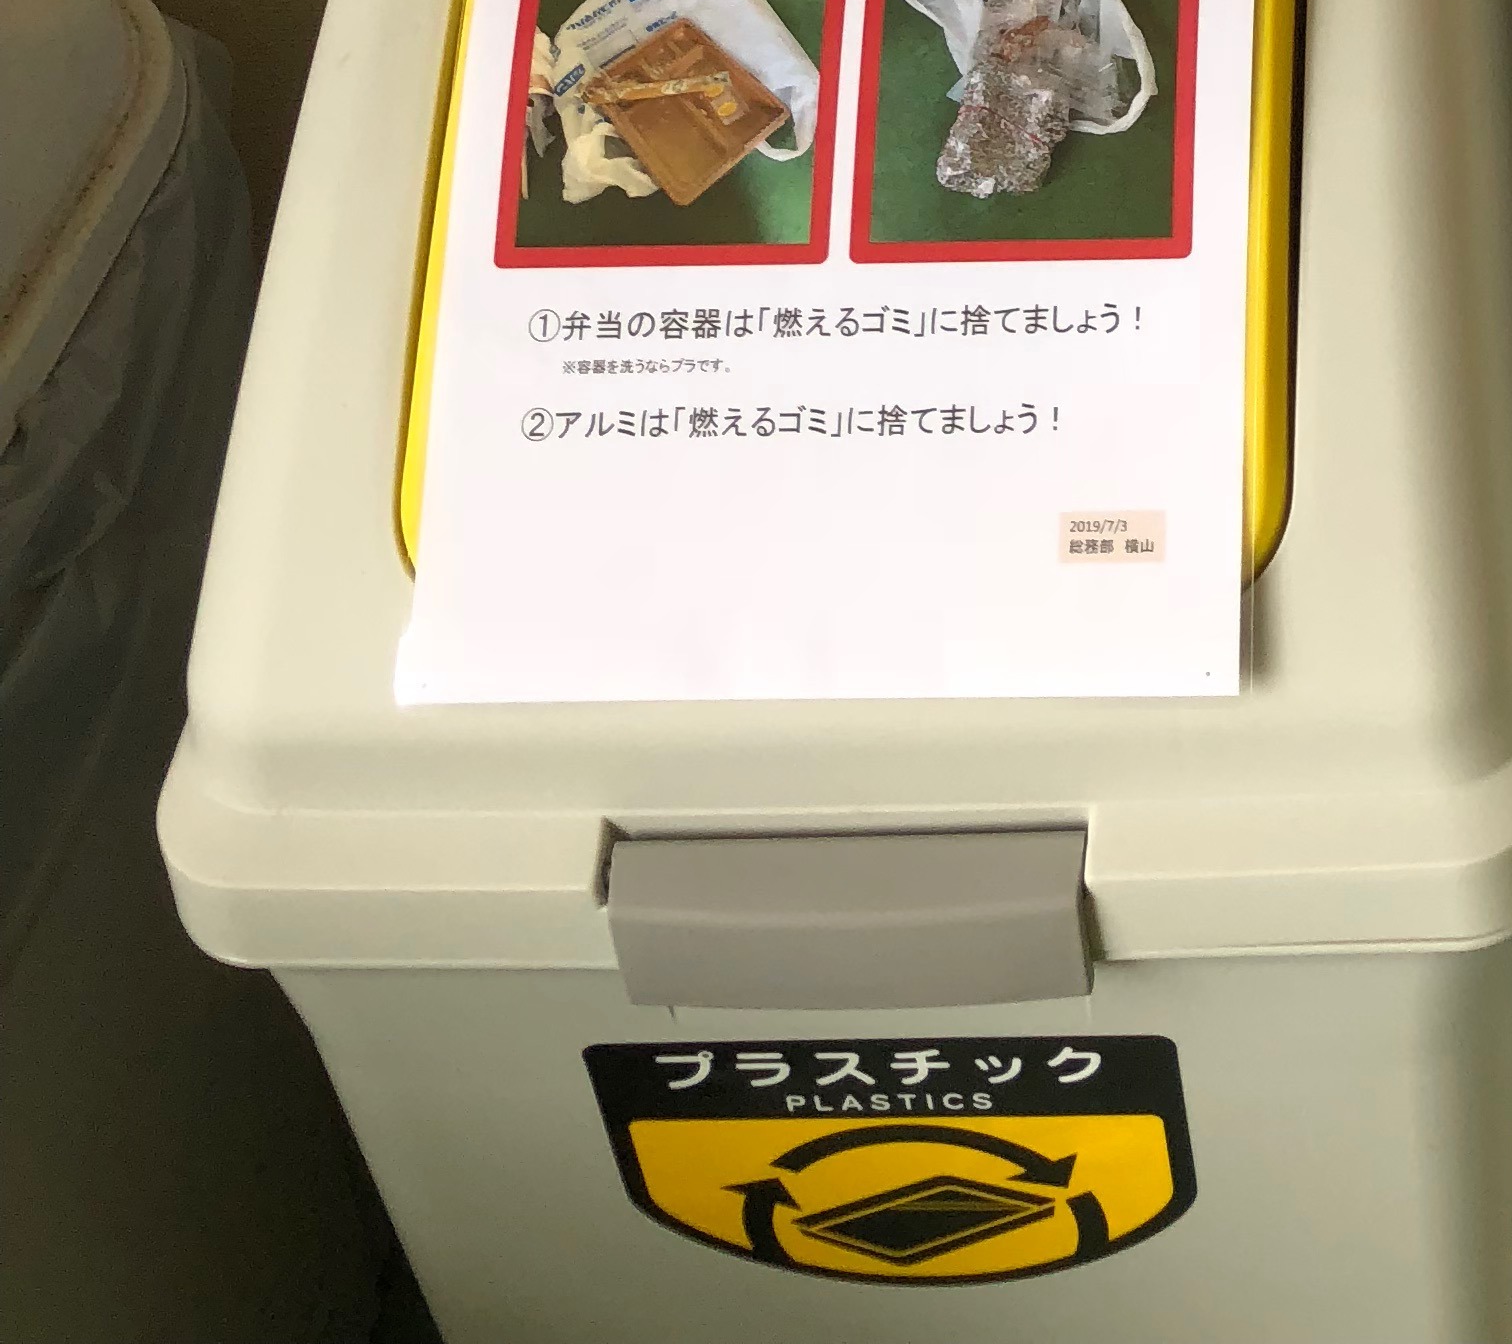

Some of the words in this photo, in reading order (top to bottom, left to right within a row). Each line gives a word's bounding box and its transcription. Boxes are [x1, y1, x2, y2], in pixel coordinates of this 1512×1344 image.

[528, 302, 1141, 342] ①弁当の容器は「燃えるゴミ」に捨てましょう！
[521, 402, 1059, 442] ②アルミは「燃えるゴミ」に捨てましょう！
[1069, 519, 1128, 534] 2019/7/3
[654, 1046, 1102, 1091] プラスチック
[786, 1092, 993, 1112] PLASTICS
